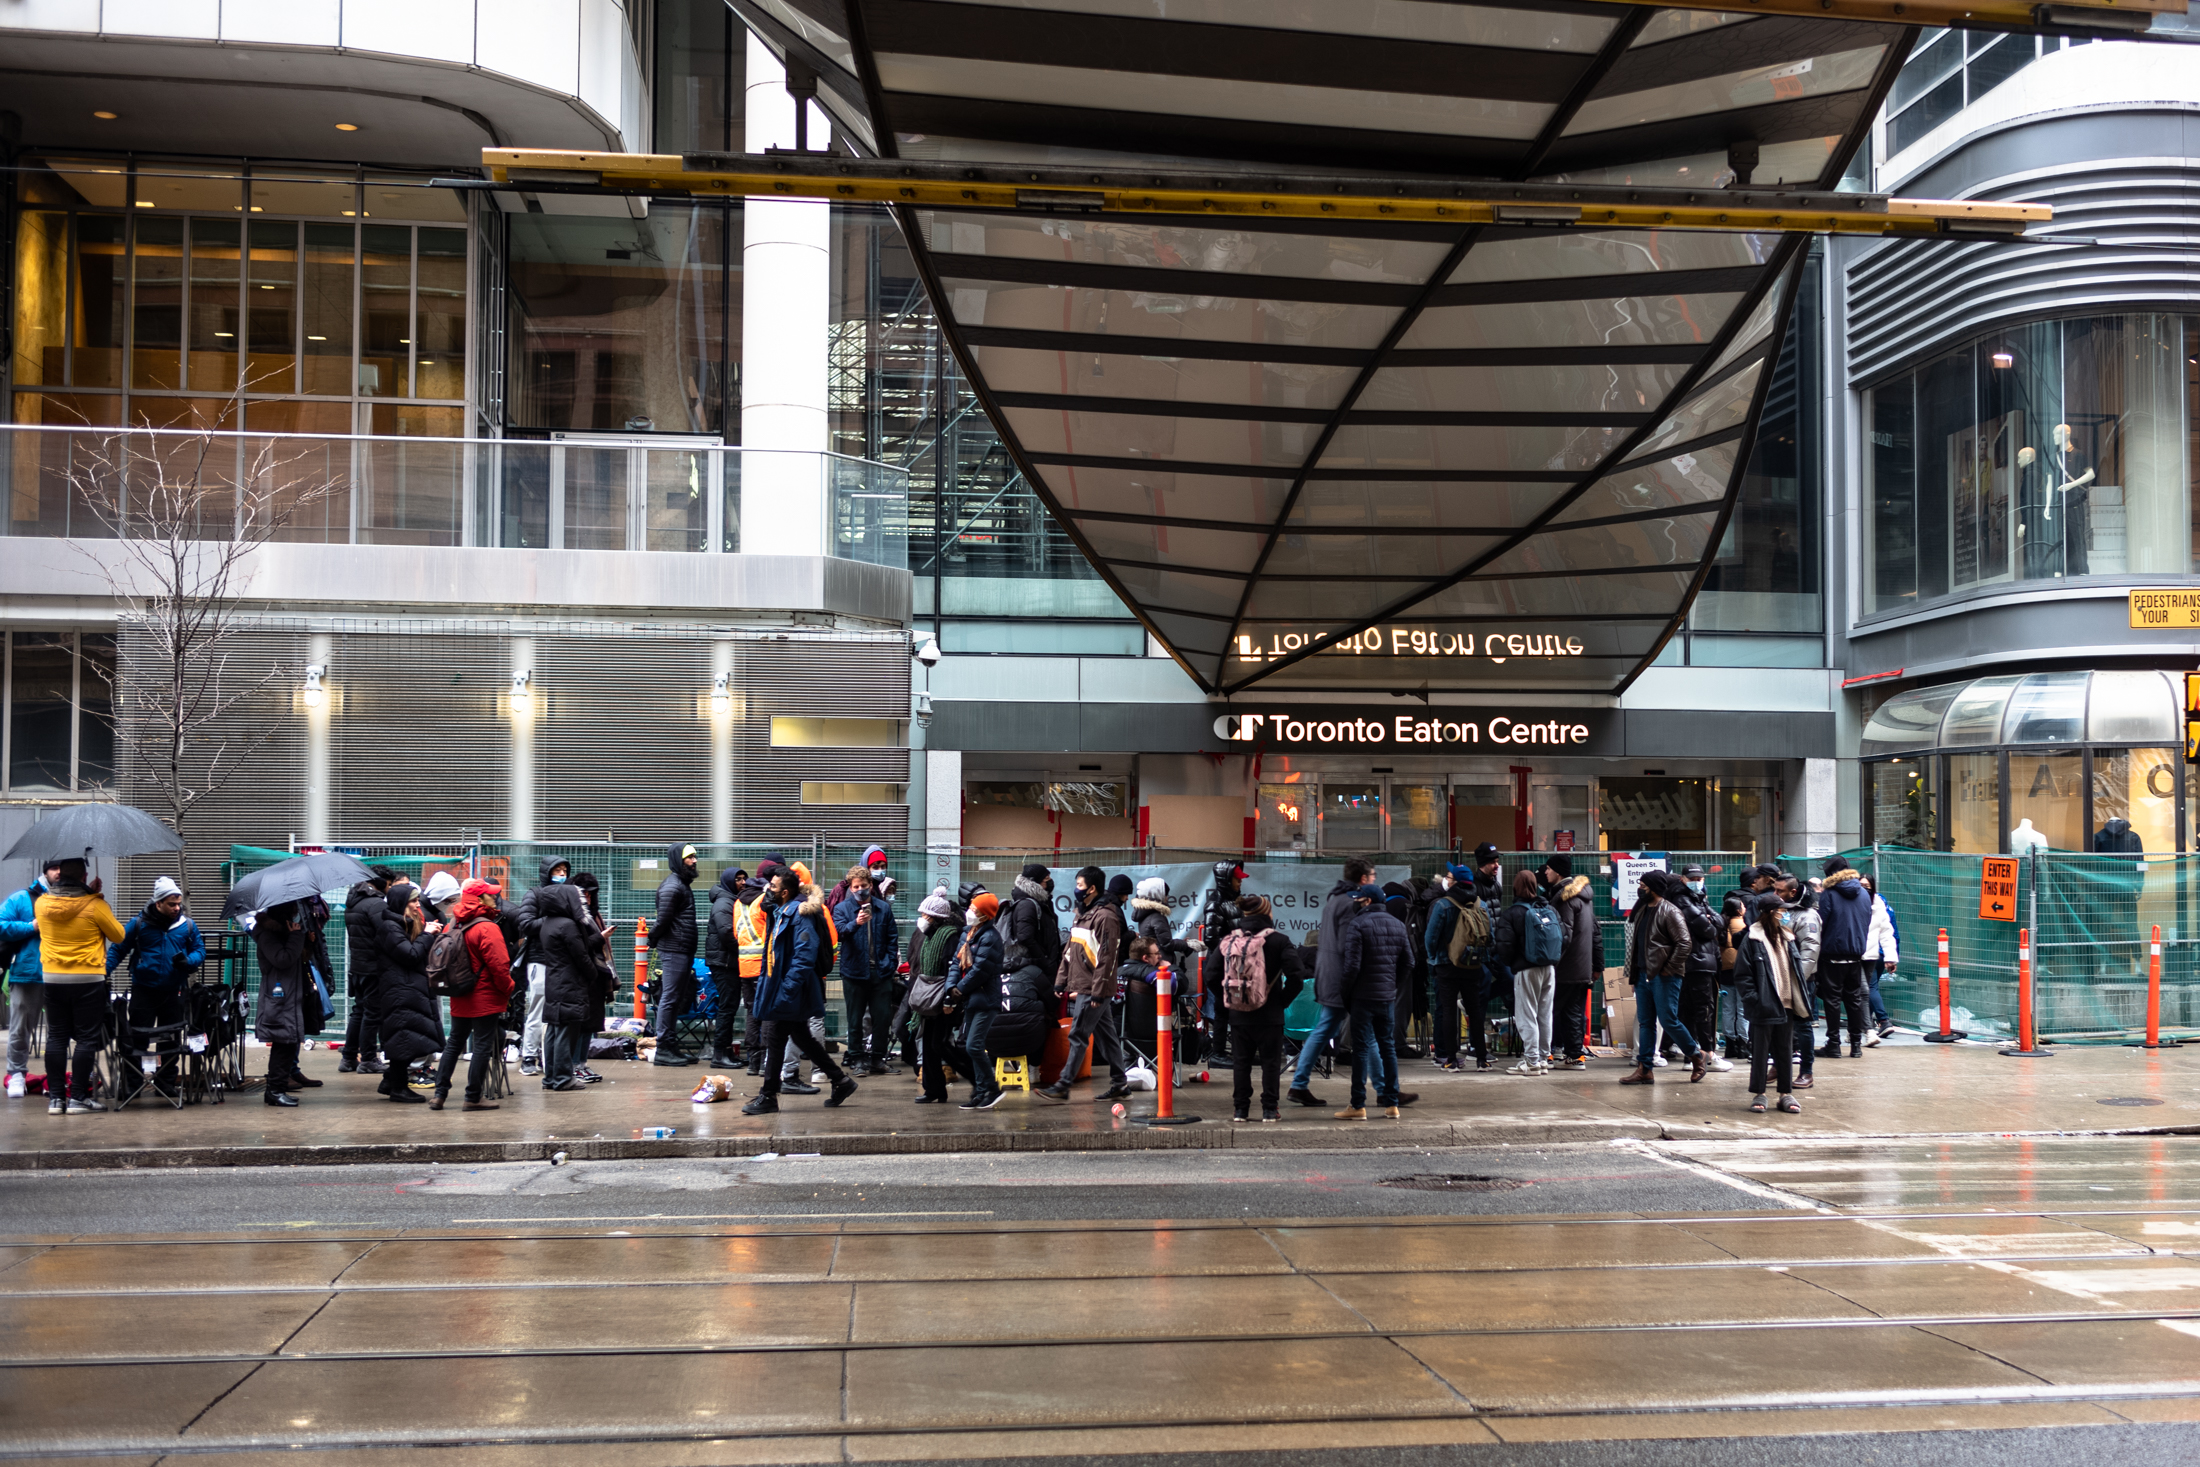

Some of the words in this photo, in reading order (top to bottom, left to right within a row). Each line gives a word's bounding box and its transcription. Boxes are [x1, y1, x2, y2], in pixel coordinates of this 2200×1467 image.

[2142, 610, 2168, 623] YOUR
[1269, 715, 1386, 742] Toronto
[1395, 716, 1479, 743] Eaton
[1488, 717, 1590, 744] Centre
[1988, 863, 2011, 878] ENTER
[1984, 881, 1998, 896] THIS
[2000, 882, 2014, 897] WAY
[1304, 891, 1319, 908] Is
